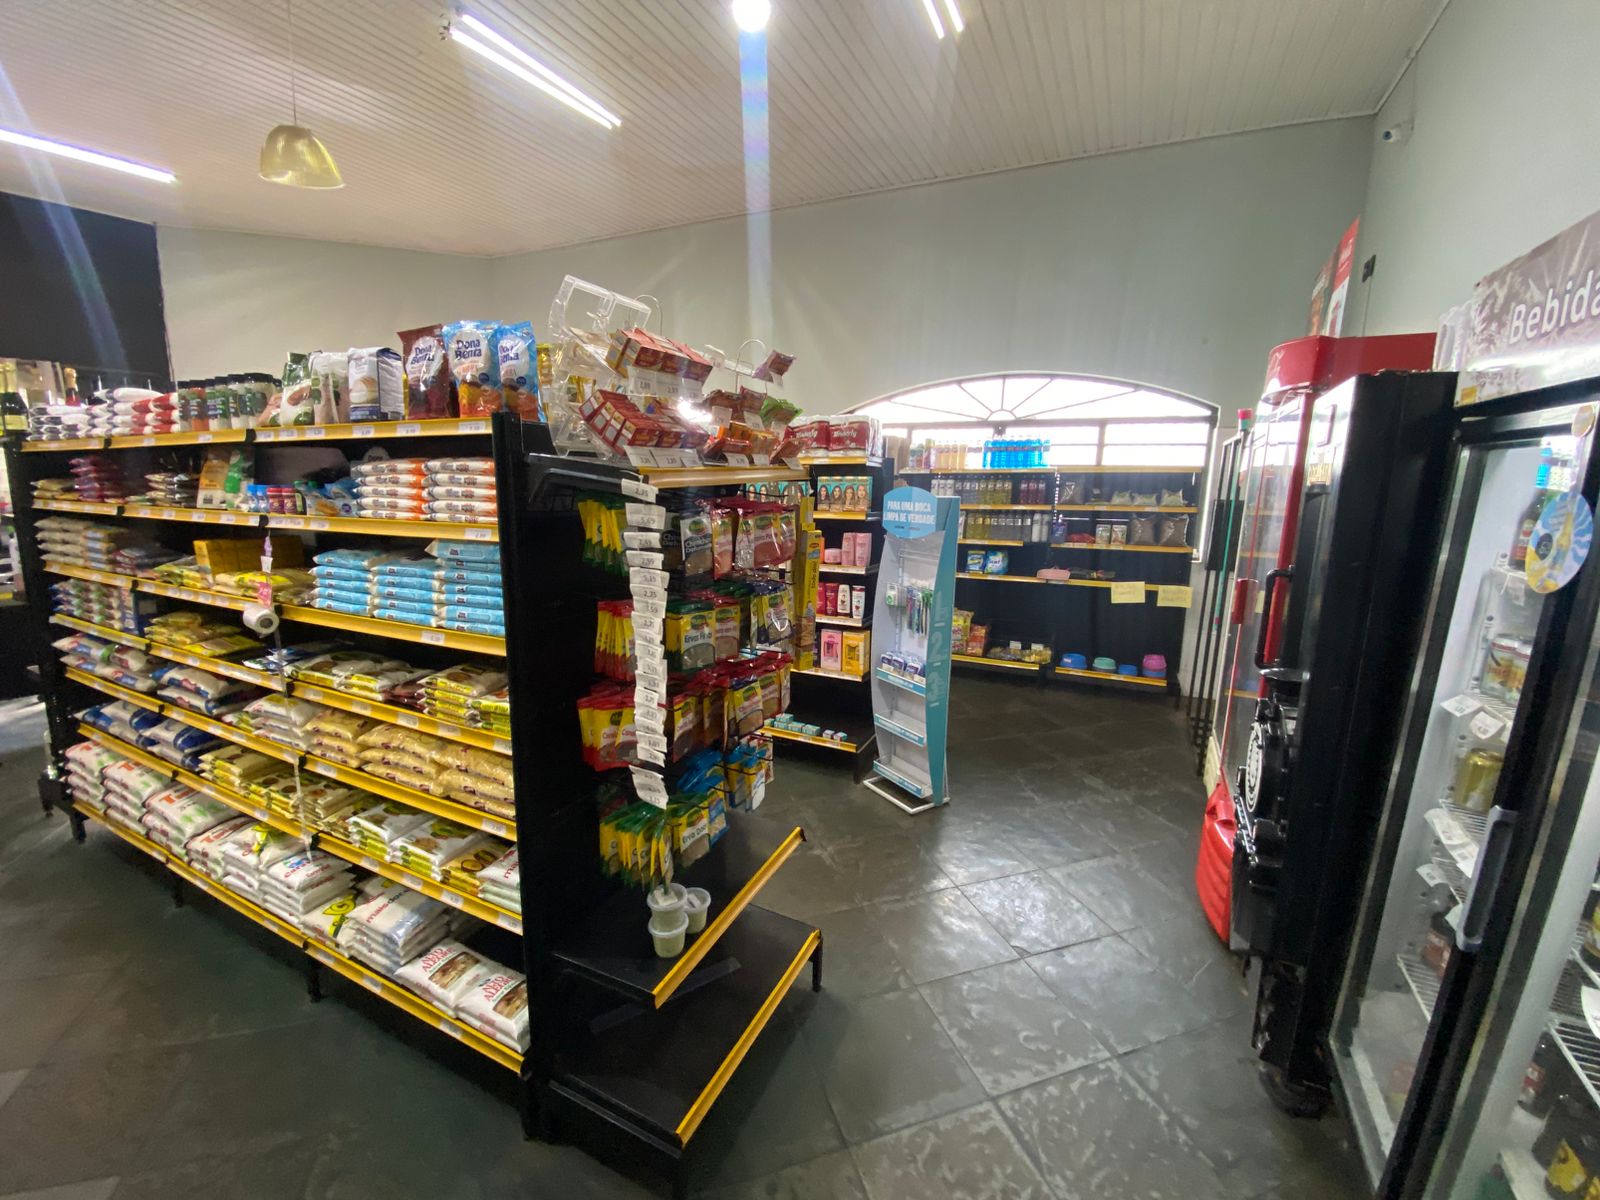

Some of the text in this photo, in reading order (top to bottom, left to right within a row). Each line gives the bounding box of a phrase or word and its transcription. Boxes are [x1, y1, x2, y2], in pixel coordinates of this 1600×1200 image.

[456, 339, 481, 351] Dona
[454, 348, 482, 361] Benta
[901, 501, 914, 512] UMA
[914, 502, 932, 513] BOCA
[908, 513, 936, 525] VERDADE
